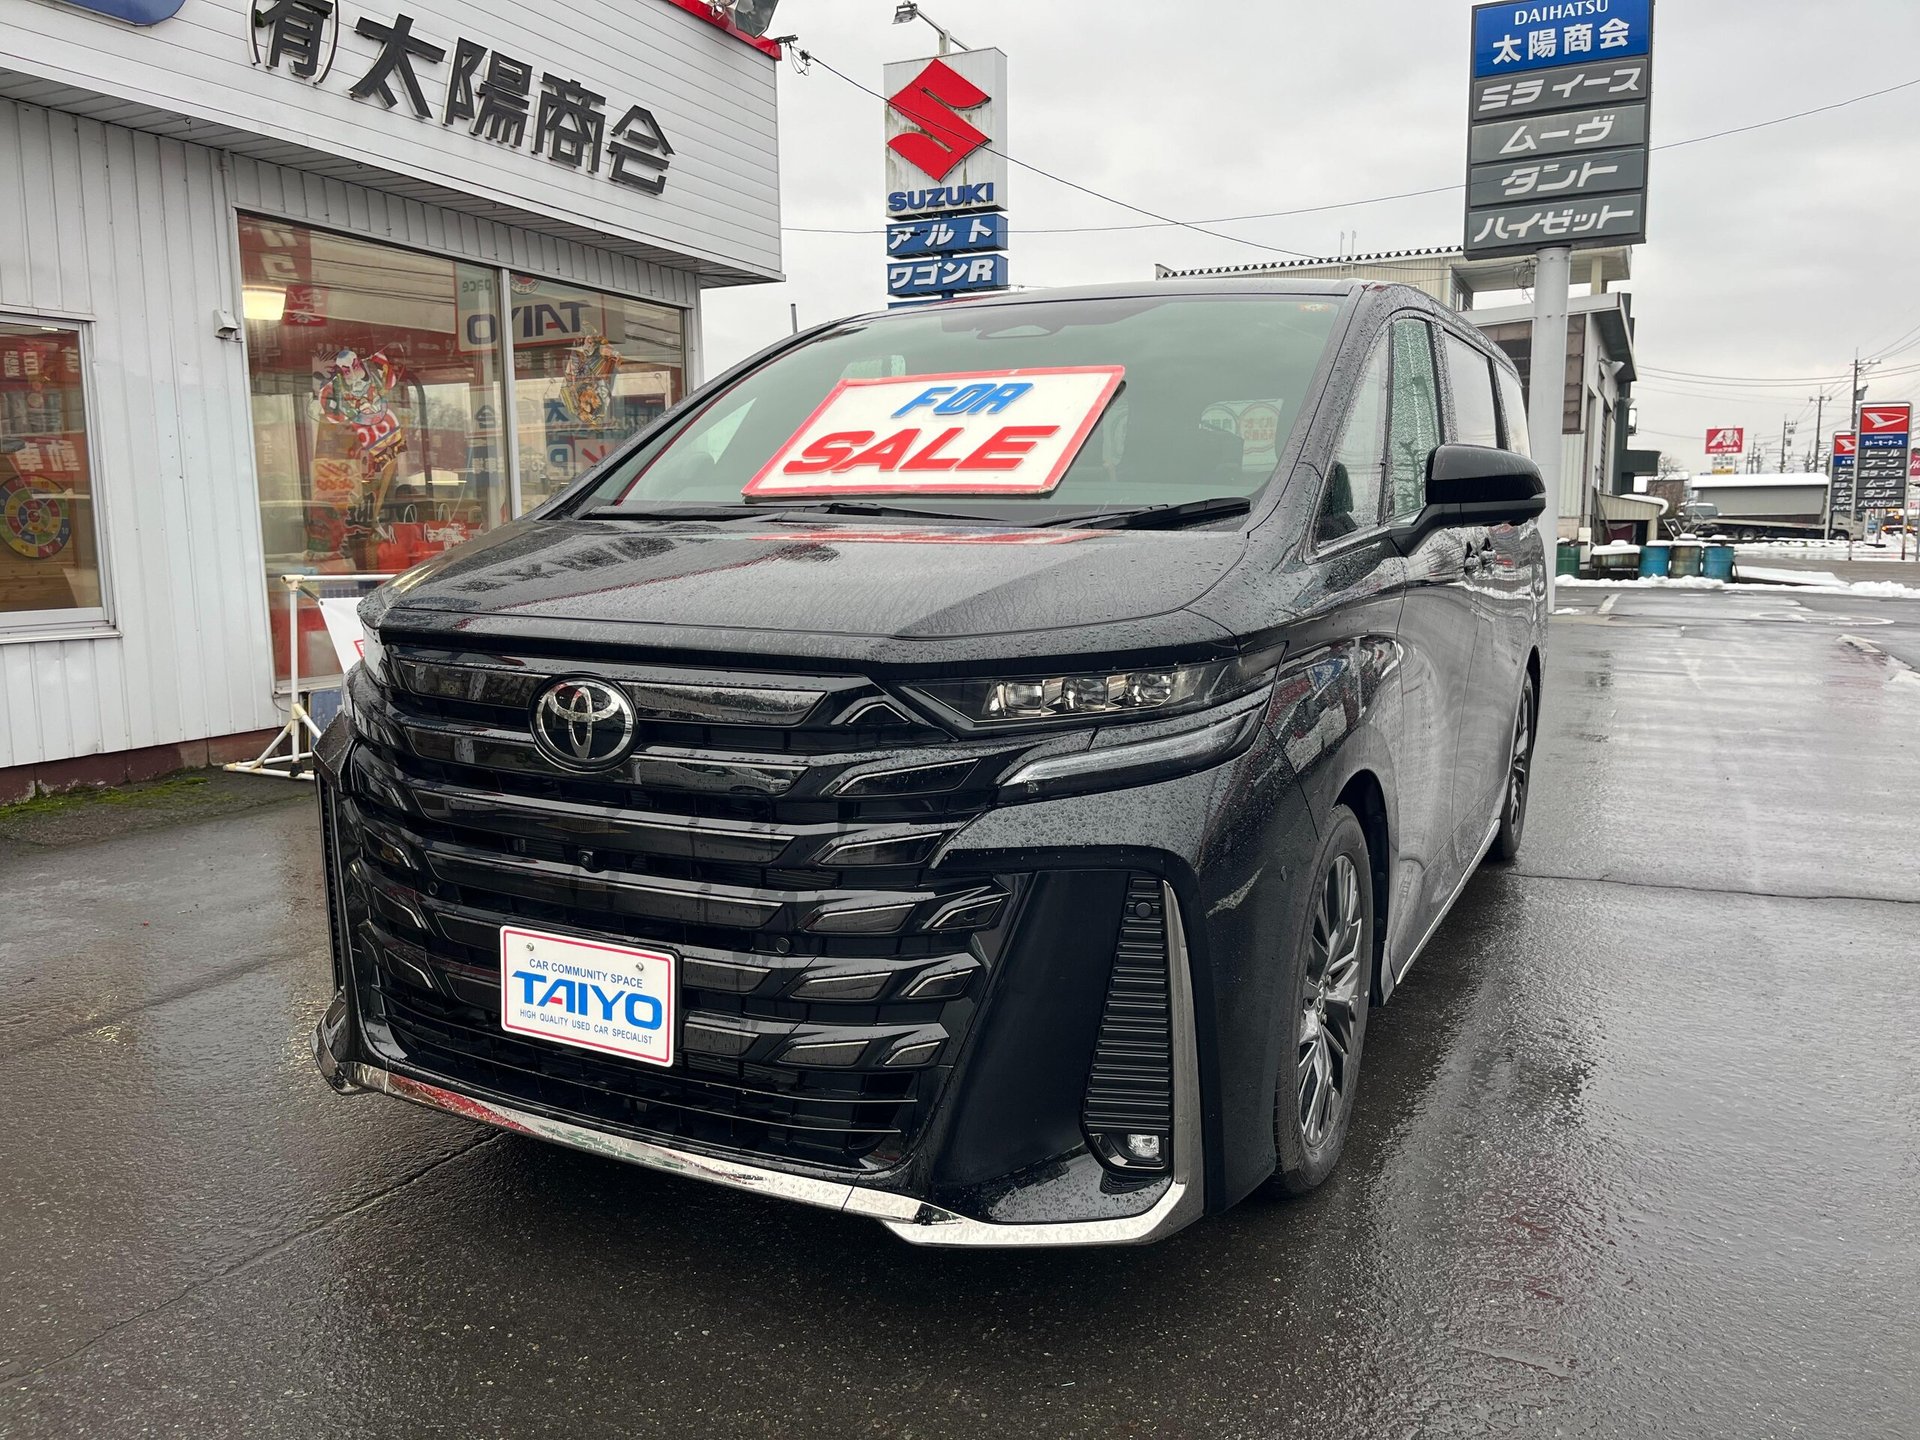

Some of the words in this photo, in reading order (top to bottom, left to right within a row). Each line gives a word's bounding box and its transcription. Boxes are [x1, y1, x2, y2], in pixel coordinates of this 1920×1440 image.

[1514, 0, 1609, 26] DAIHATSU
[1492, 17, 1630, 65] 太陽商会
[1499, 114, 1615, 154] ムーヴ
[887, 181, 994, 212] SUZUKI
[1501, 161, 1618, 196] タント
[889, 218, 993, 250] アルト
[1473, 204, 1634, 243] ハイゼット
[889, 258, 994, 290] ワゴンR
[890, 382, 1035, 418] FOR
[782, 425, 1060, 475] SALE
[529, 958, 549, 971] CAR
[551, 962, 608, 982] COMMUNITY
[610, 973, 643, 989] SPACE
[512, 970, 663, 1031] TAIYO
[519, 1009, 536, 1020] HIGH
[539, 1012, 568, 1027] QUALITY
[571, 1019, 590, 1031] USED
[594, 1024, 609, 1035] CAR
[612, 1028, 653, 1045] SPECIALIST
